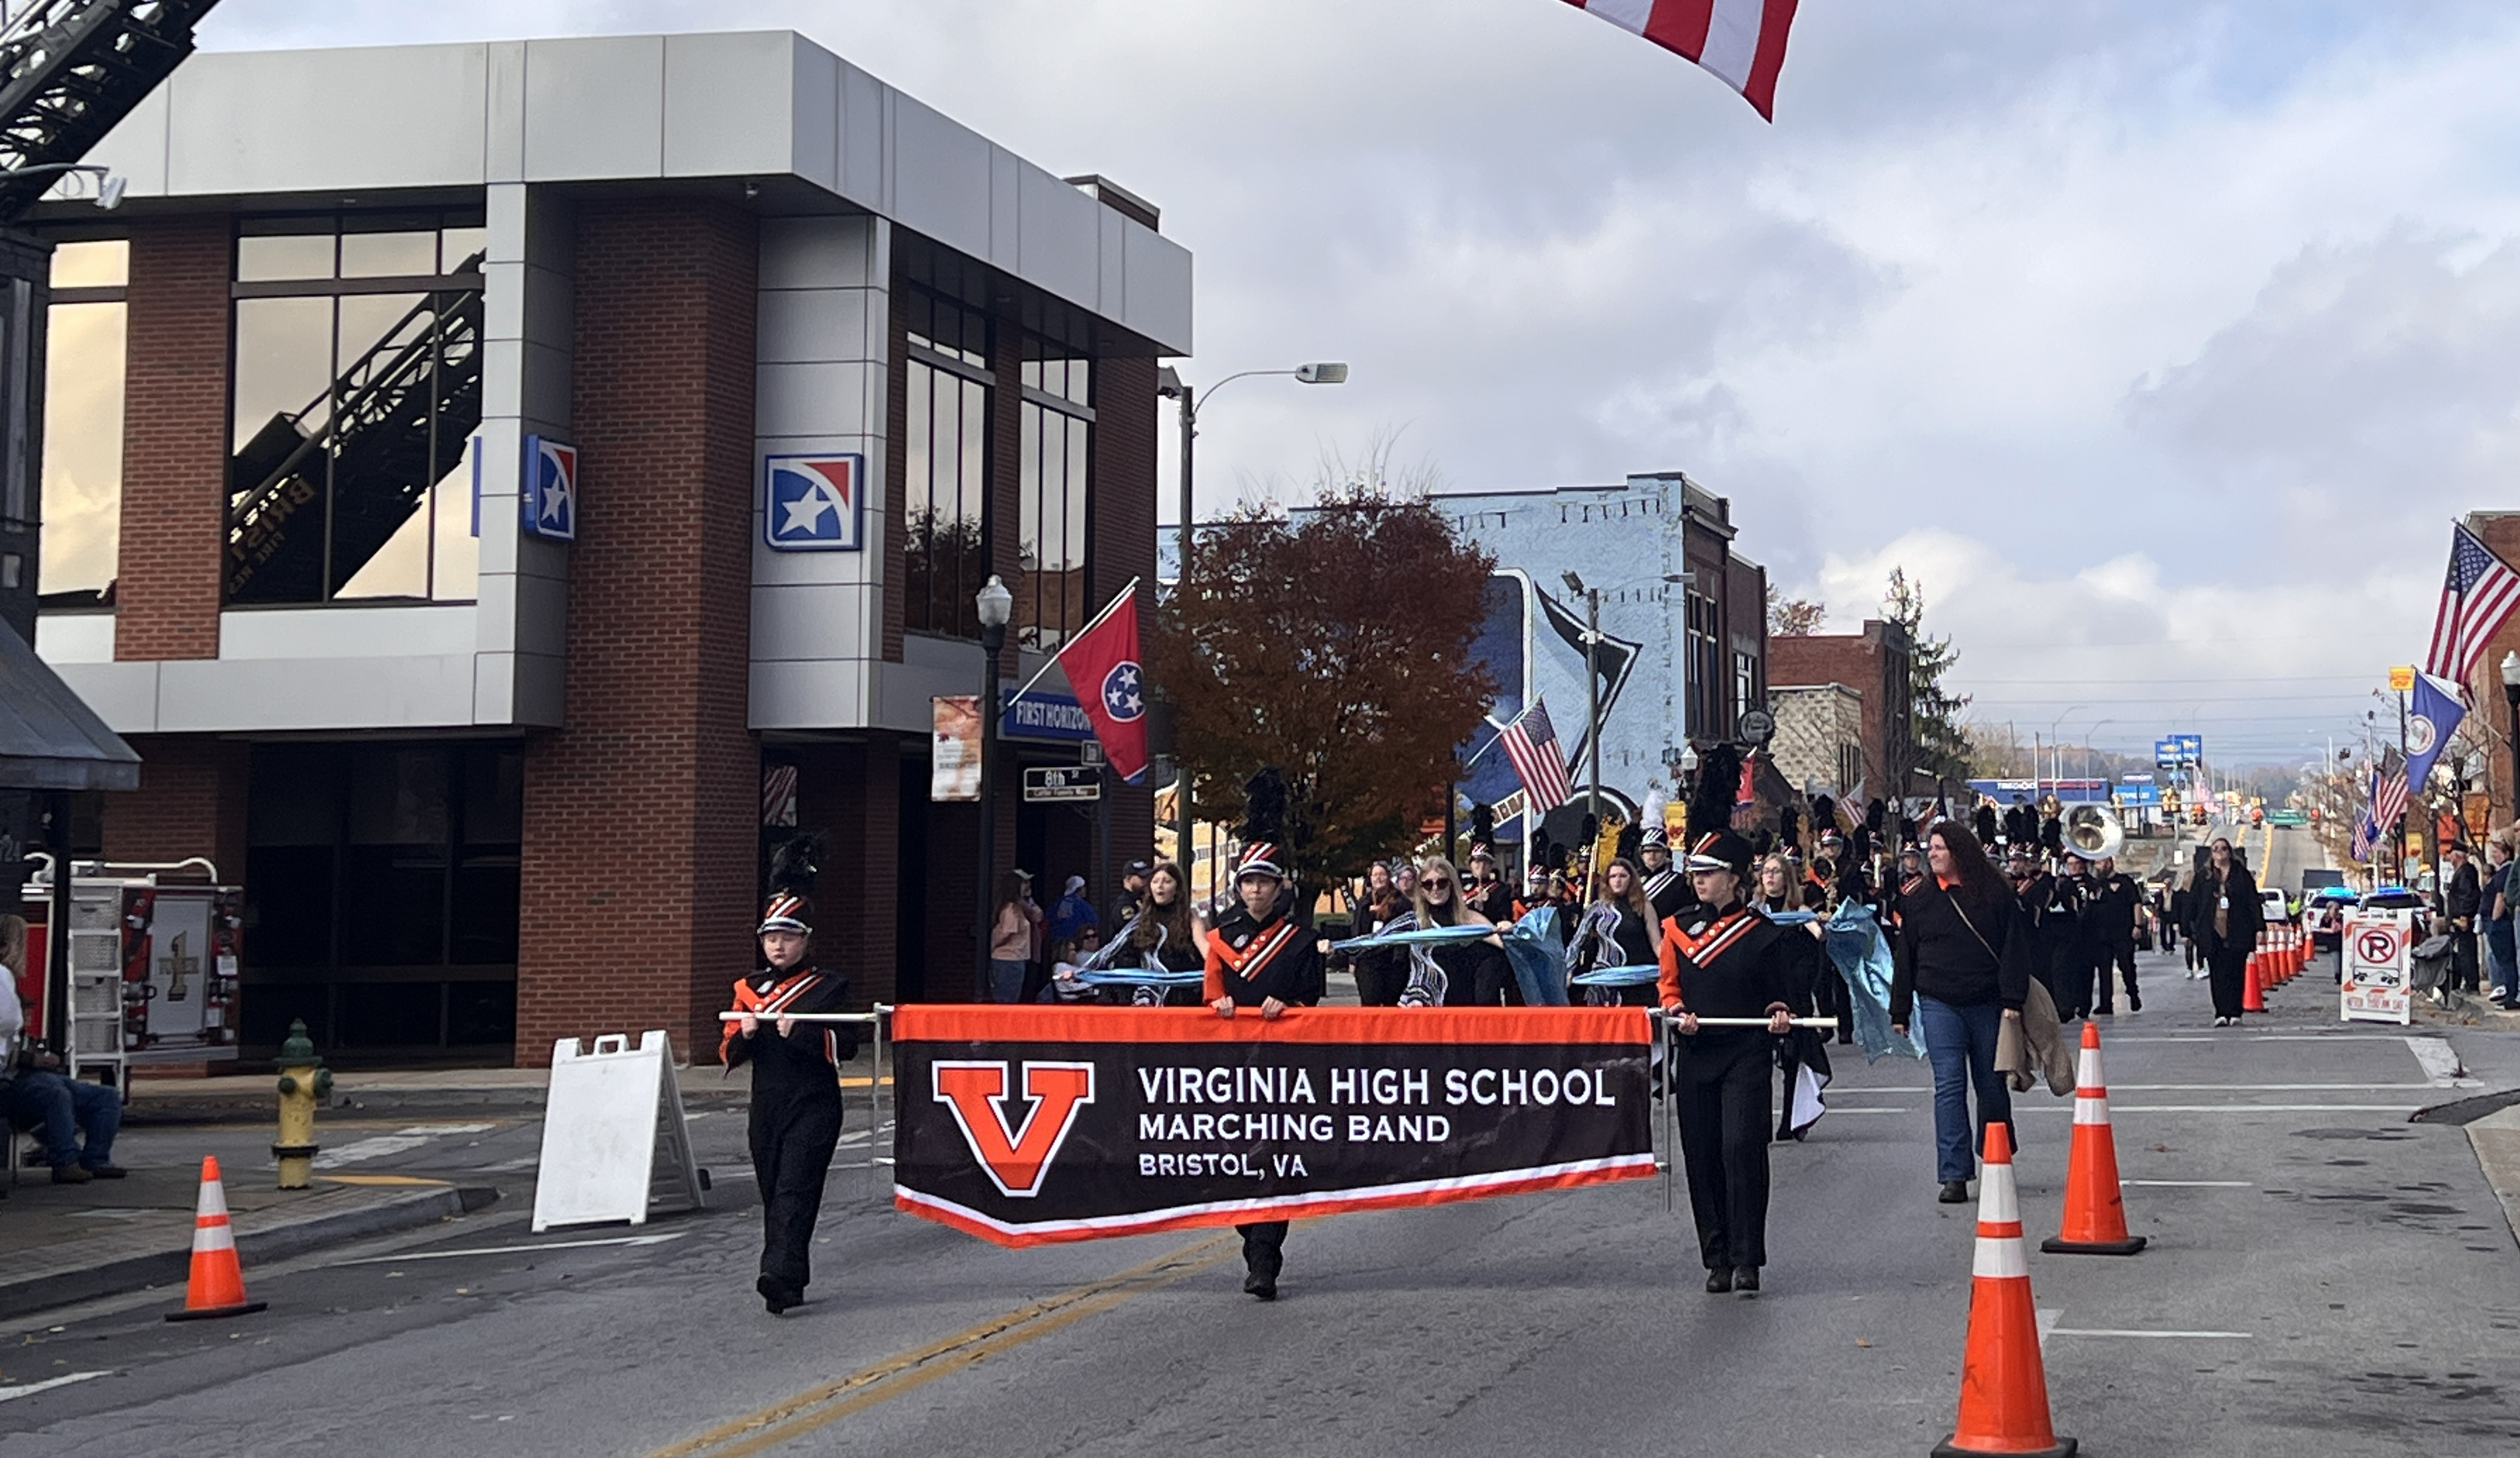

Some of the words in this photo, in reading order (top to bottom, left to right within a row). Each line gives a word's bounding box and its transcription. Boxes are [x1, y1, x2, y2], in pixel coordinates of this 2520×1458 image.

[1016, 701, 1045, 726] FIRST
[1045, 769, 1065, 787] 8th
[1137, 1067, 1316, 1104] VIRGINIA
[1330, 1068, 1429, 1105] HIGH
[1445, 1068, 1616, 1107] SCHOOL
[932, 1060, 1094, 1197] V
[1139, 1114, 1334, 1140] MARCHING
[1348, 1114, 1450, 1142] BAND
[1139, 1153, 1266, 1180] BRISTOL,
[1273, 1154, 1308, 1177] VA
